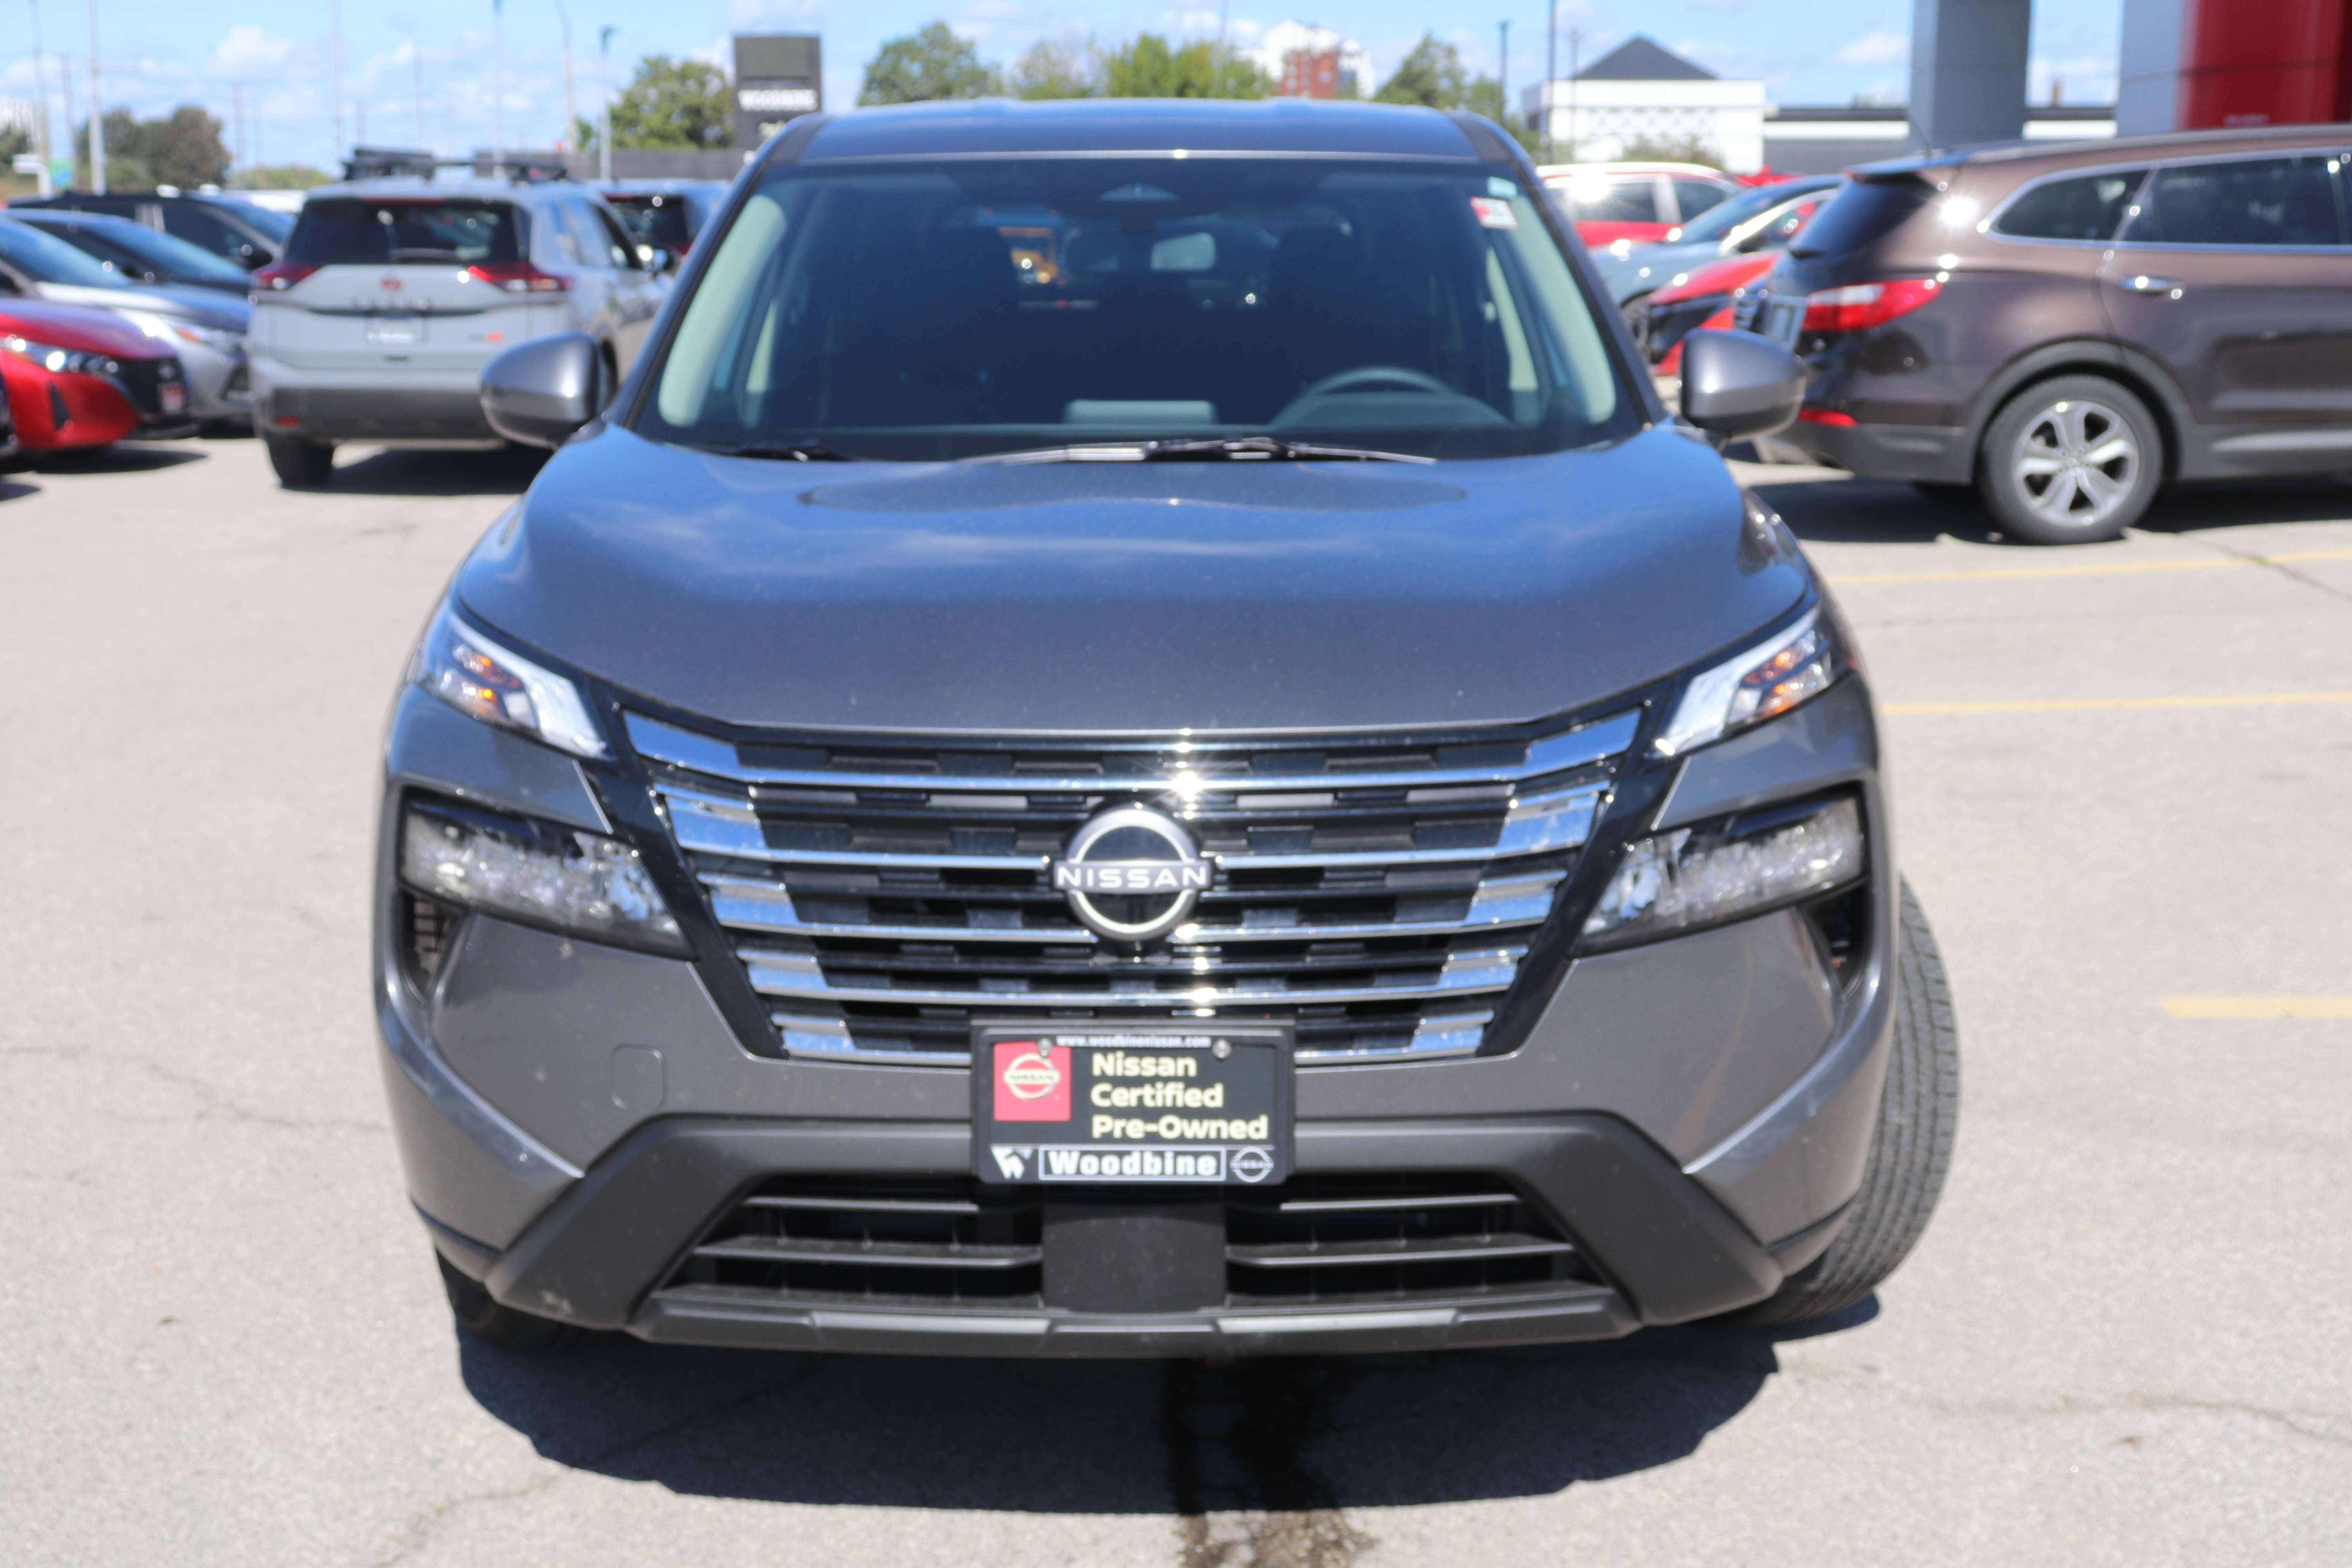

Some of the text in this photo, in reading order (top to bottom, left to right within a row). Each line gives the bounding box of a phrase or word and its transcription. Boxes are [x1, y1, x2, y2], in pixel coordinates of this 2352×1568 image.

[1057, 866, 1206, 889] NISSAN
[1092, 1052, 1197, 1077] Nissan
[1090, 1082, 1223, 1108] Certified
[1092, 1114, 1268, 1140] Pre-Owned
[1048, 1150, 1218, 1176] Woodbine
